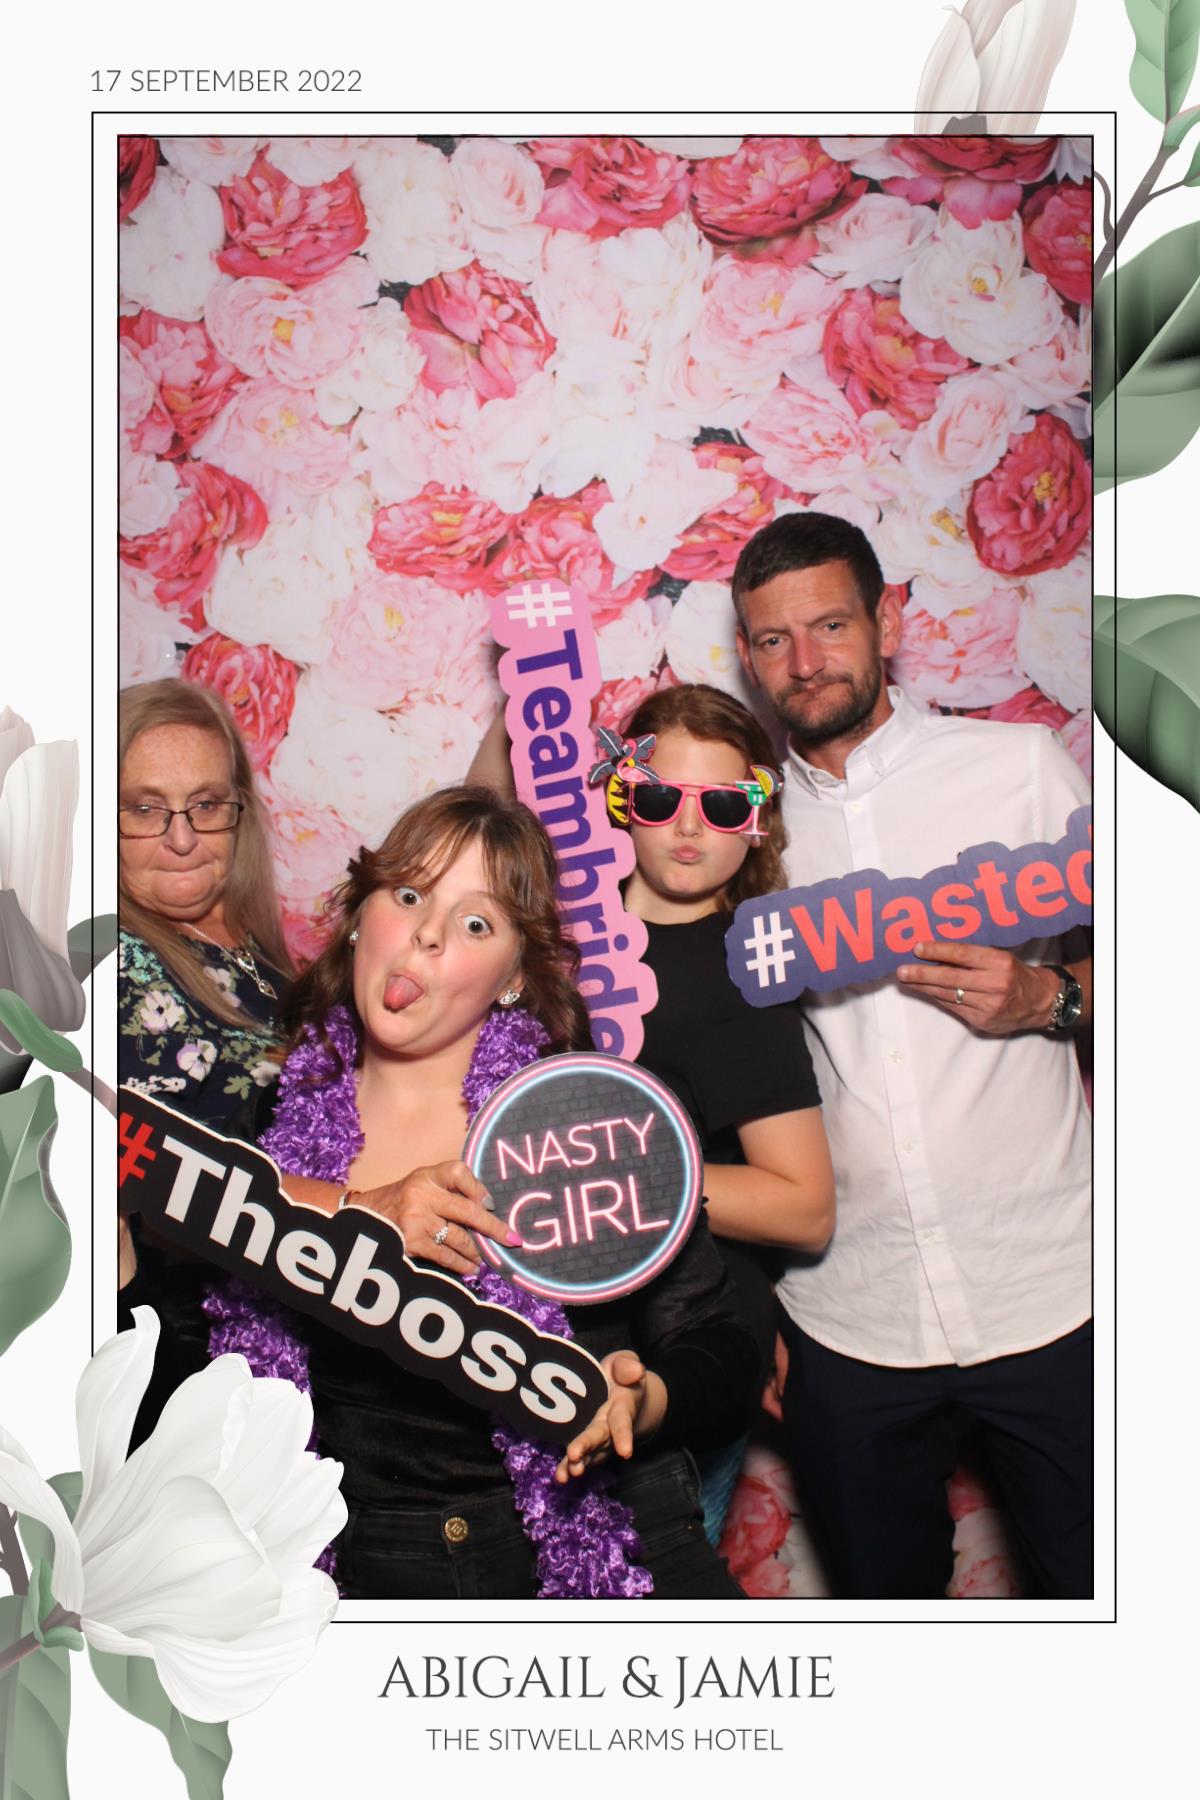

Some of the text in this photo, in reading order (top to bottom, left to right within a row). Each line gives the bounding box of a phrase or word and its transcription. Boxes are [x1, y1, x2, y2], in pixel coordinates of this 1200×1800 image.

[496, 1112, 655, 1180] NASTY
[508, 1174, 670, 1251] GIRL
[118, 1111, 588, 1425] #Theboss
